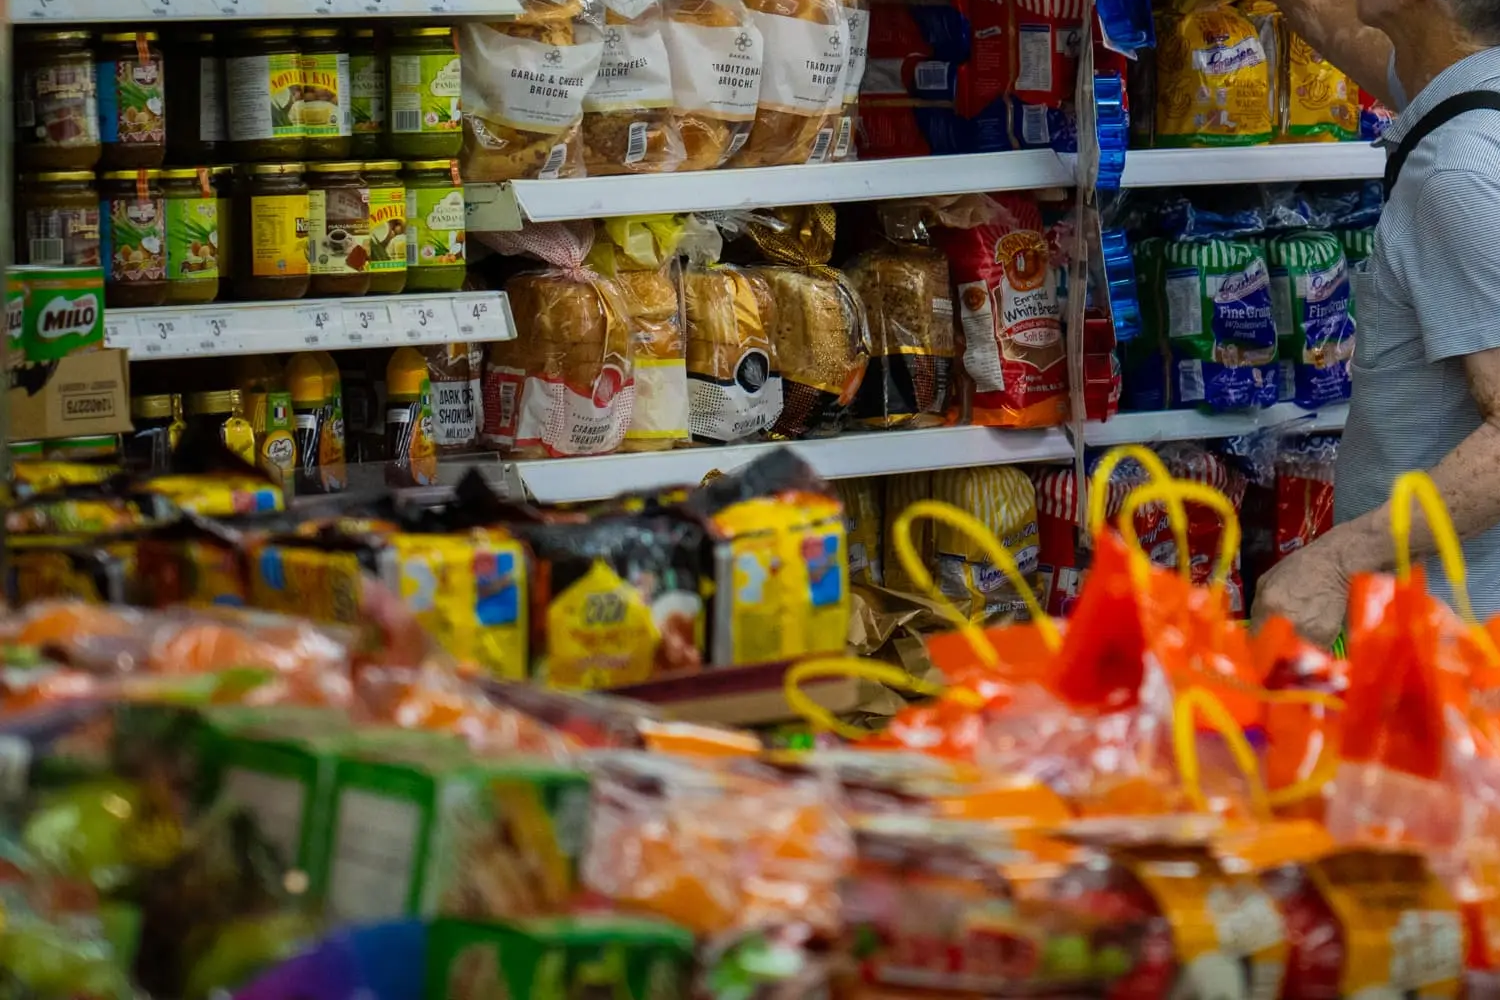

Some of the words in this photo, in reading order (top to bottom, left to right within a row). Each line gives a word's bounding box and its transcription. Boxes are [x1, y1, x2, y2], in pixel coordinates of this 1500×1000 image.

[510, 68, 545, 83] GARLIC
[548, 75, 555, 85] &
[558, 75, 585, 87] CHEESE
[529, 84, 570, 100] BRIOCHE
[1013, 290, 1049, 307] Enriched
[42, 305, 95, 331] MILO
[1003, 304, 1038, 323] White
[1219, 305, 1246, 319] Fine
